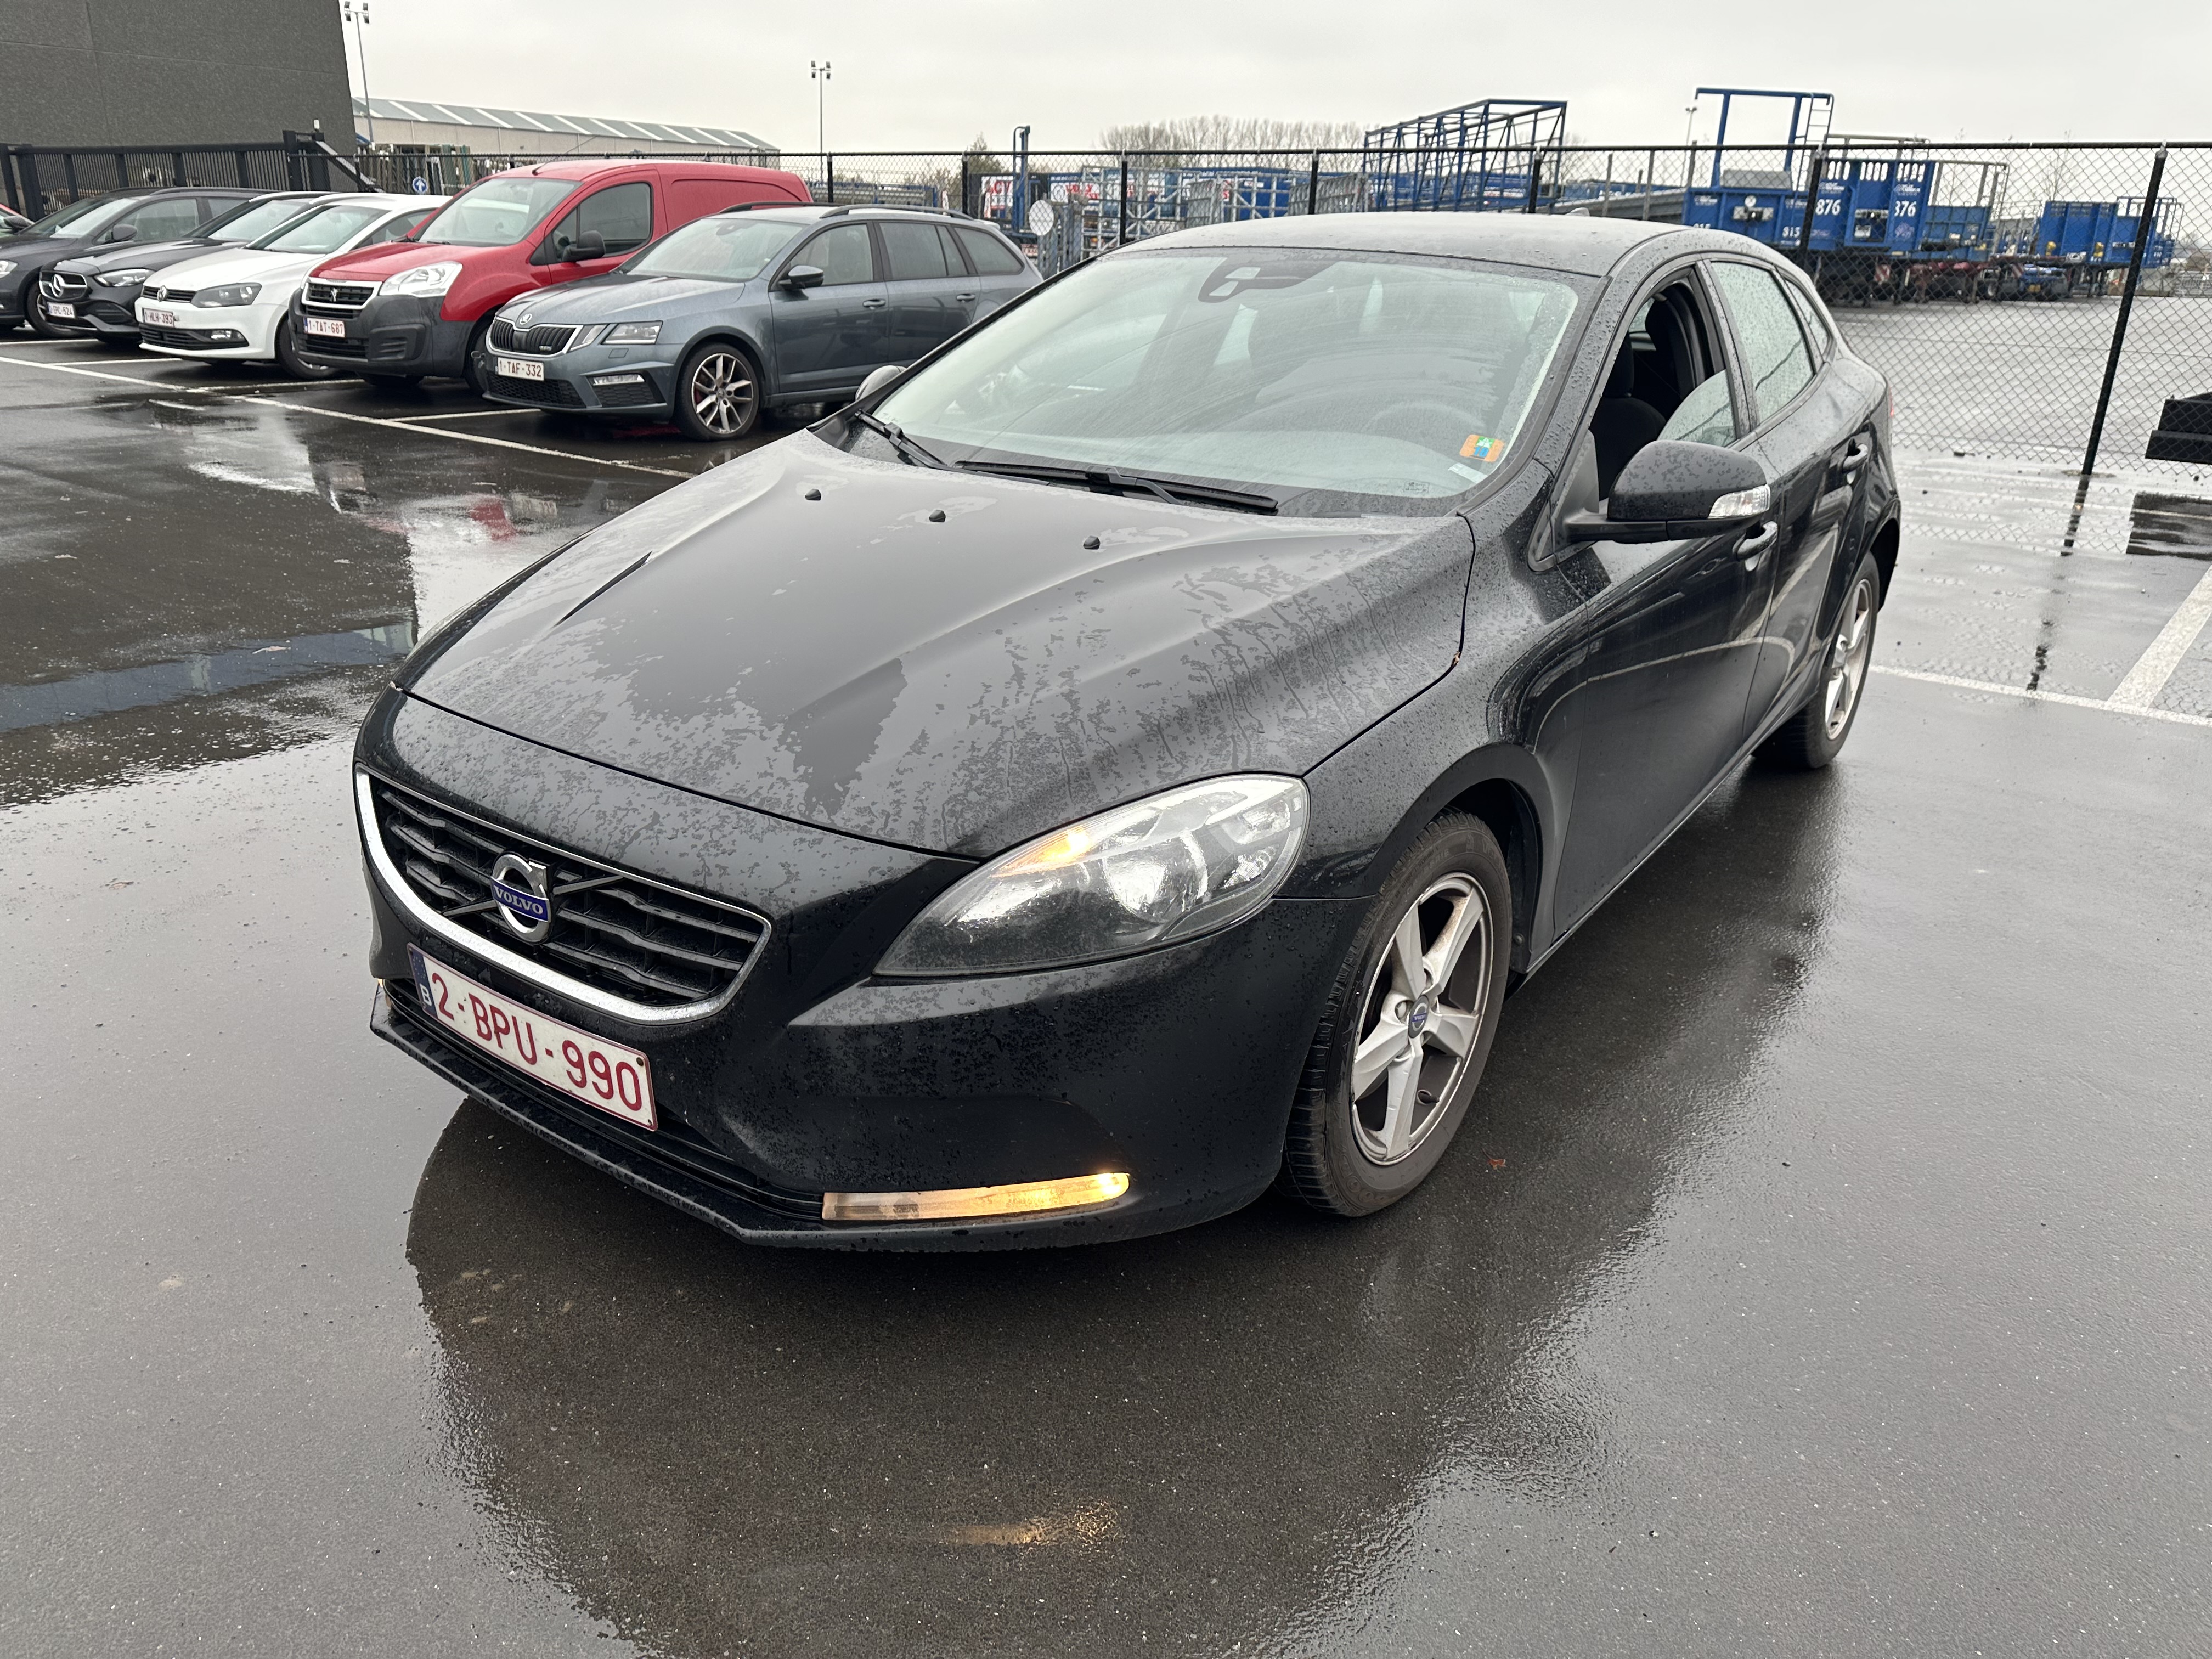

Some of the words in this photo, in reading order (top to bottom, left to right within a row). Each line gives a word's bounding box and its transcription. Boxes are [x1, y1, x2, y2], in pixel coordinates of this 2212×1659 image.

[1815, 199, 1841, 216] 876
[309, 320, 343, 334] 1-TAT-687
[500, 360, 541, 377] 1-TAF-332
[494, 884, 543, 915] VOLVO
[420, 984, 432, 1007] B
[432, 972, 642, 1111] 2-BPU-990
